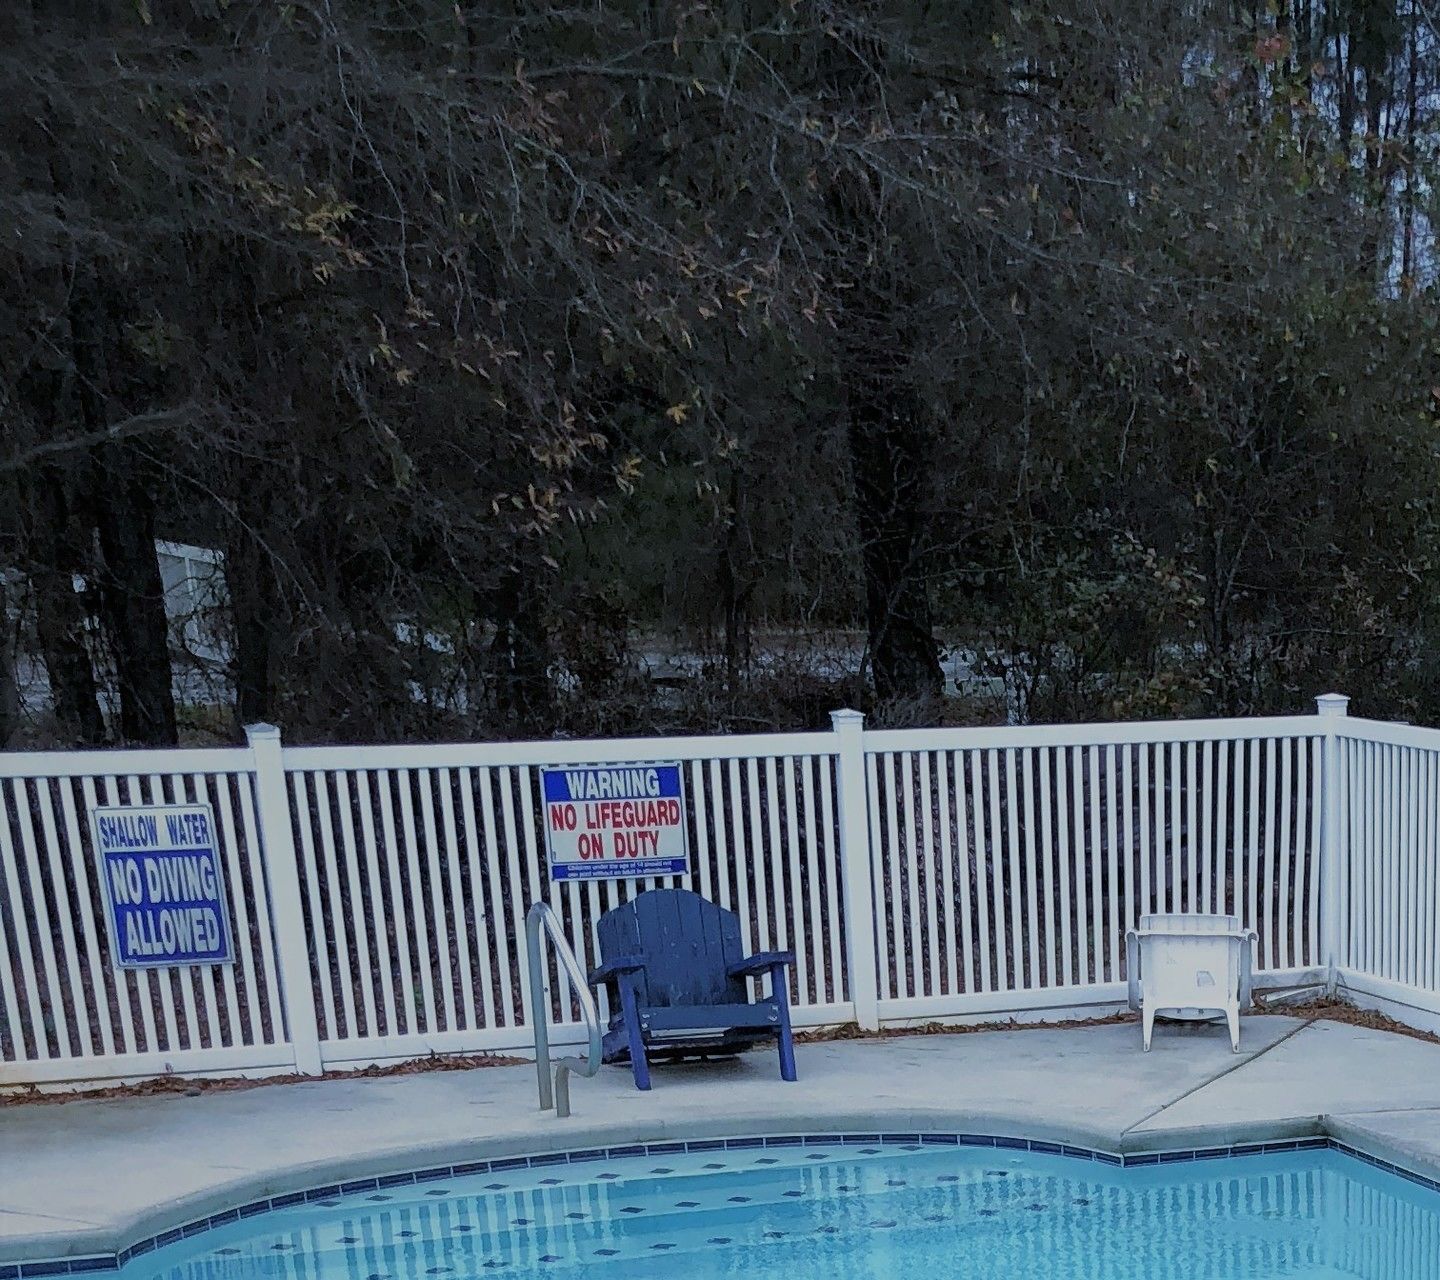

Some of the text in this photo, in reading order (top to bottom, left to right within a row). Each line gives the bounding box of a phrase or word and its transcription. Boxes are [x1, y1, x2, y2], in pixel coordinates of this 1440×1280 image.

[565, 768, 661, 800] WARNING
[99, 813, 210, 849] SHALLOW WATER
[551, 799, 680, 831] NO LIFEGUARD
[578, 830, 660, 860] ON DUTY
[109, 855, 218, 905] NO DIVING
[126, 907, 221, 955] ALLOWED
